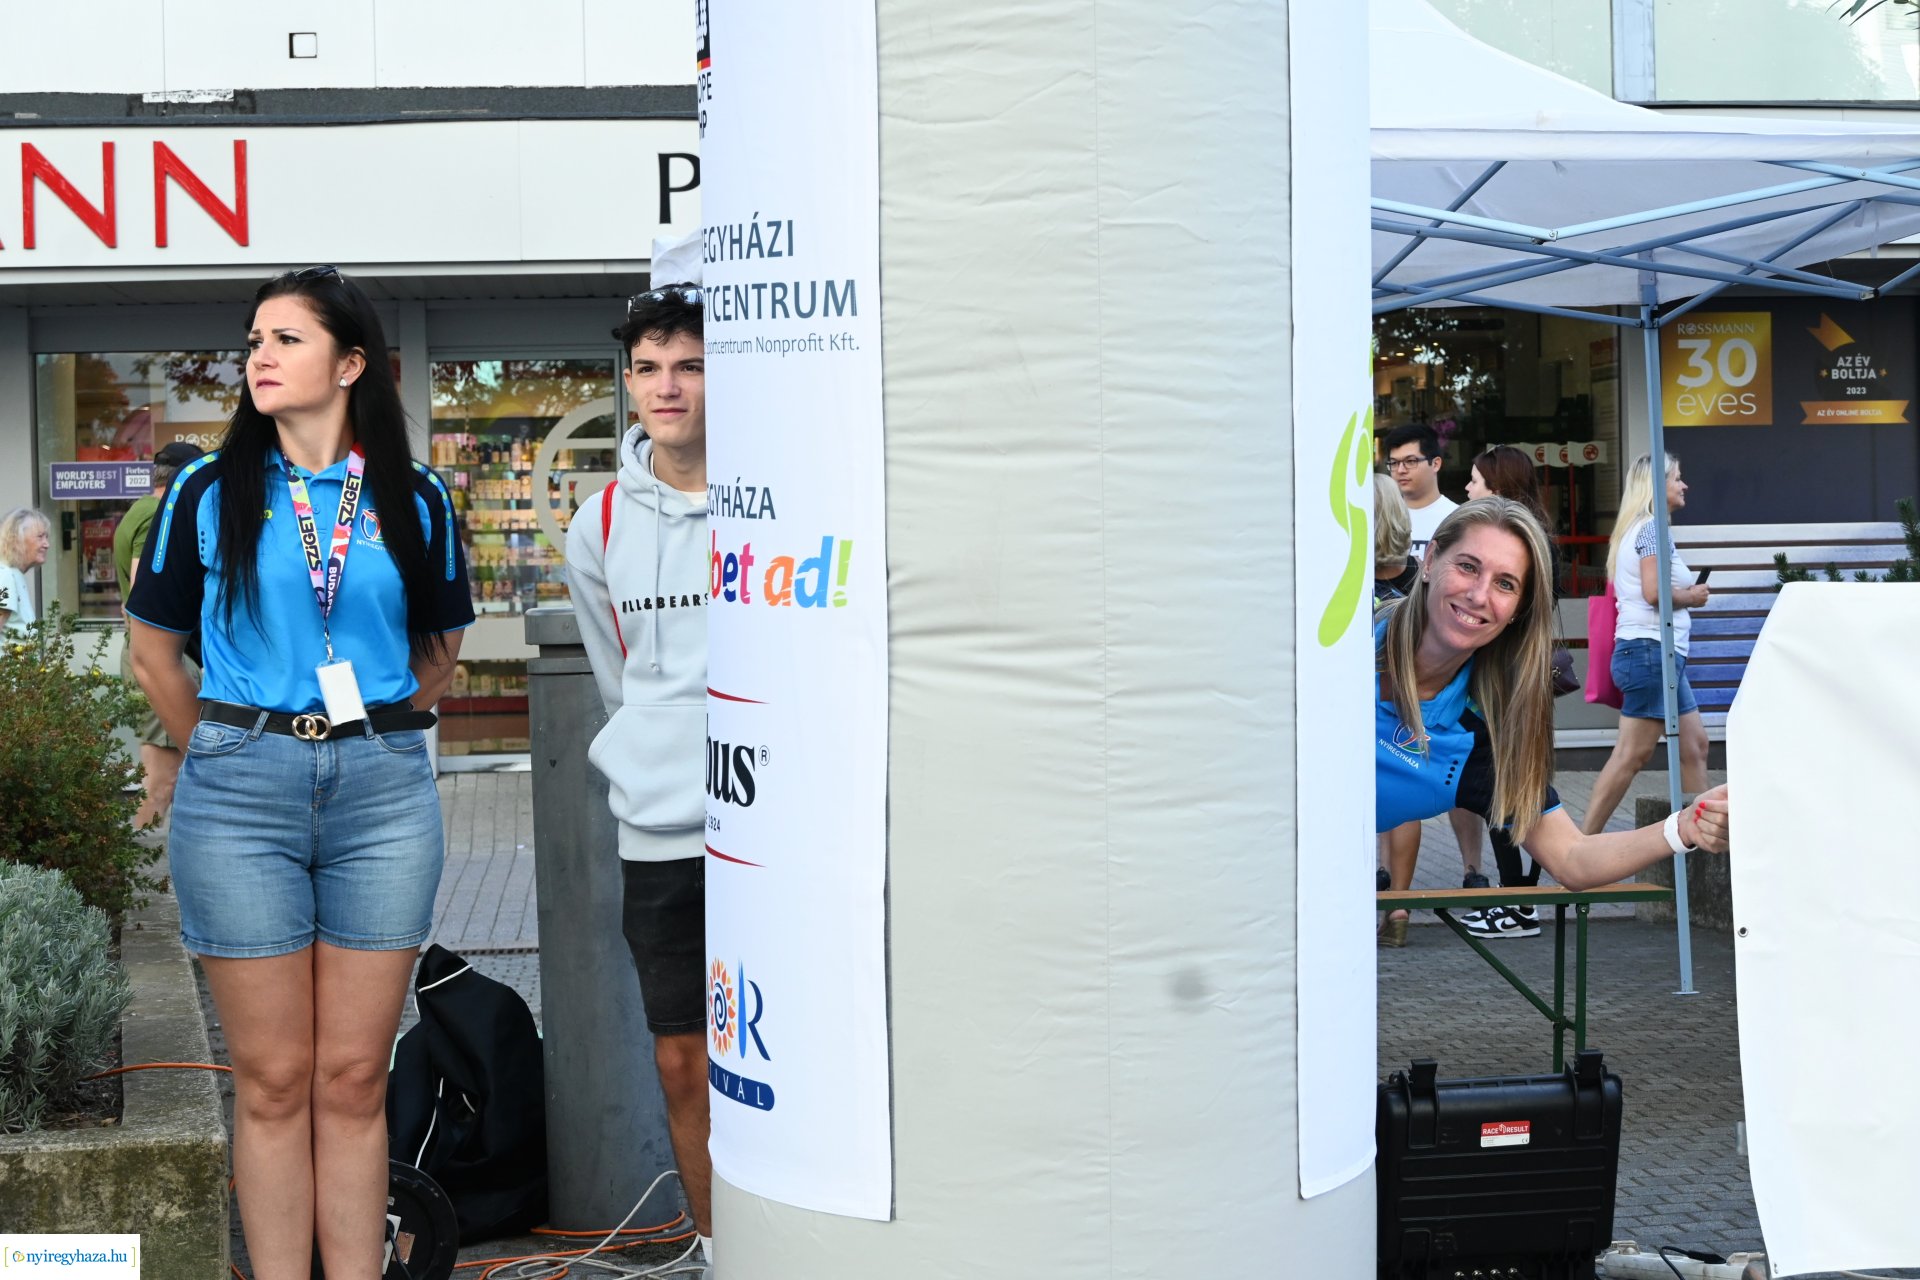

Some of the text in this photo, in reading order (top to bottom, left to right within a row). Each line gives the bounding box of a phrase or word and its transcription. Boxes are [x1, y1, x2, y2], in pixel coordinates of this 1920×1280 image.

[0, 140, 249, 249] NN
[1677, 323, 1755, 335] ROSSMANN
[755, 332, 824, 357] Nonprofit
[829, 332, 860, 352] Kft.
[1676, 338, 1757, 387] 30
[1837, 353, 1870, 367] AZ ÉV
[1831, 368, 1877, 380] BOLTJA
[1846, 387, 1867, 395] 2023
[1676, 387, 1757, 416] éves
[56, 466, 150, 481] WORLD'S BEST Forbes
[56, 476, 148, 490] EMPLOYERS 2022
[763, 535, 853, 608] ad!
[1482, 1125, 1529, 1135] RACE RESULT
